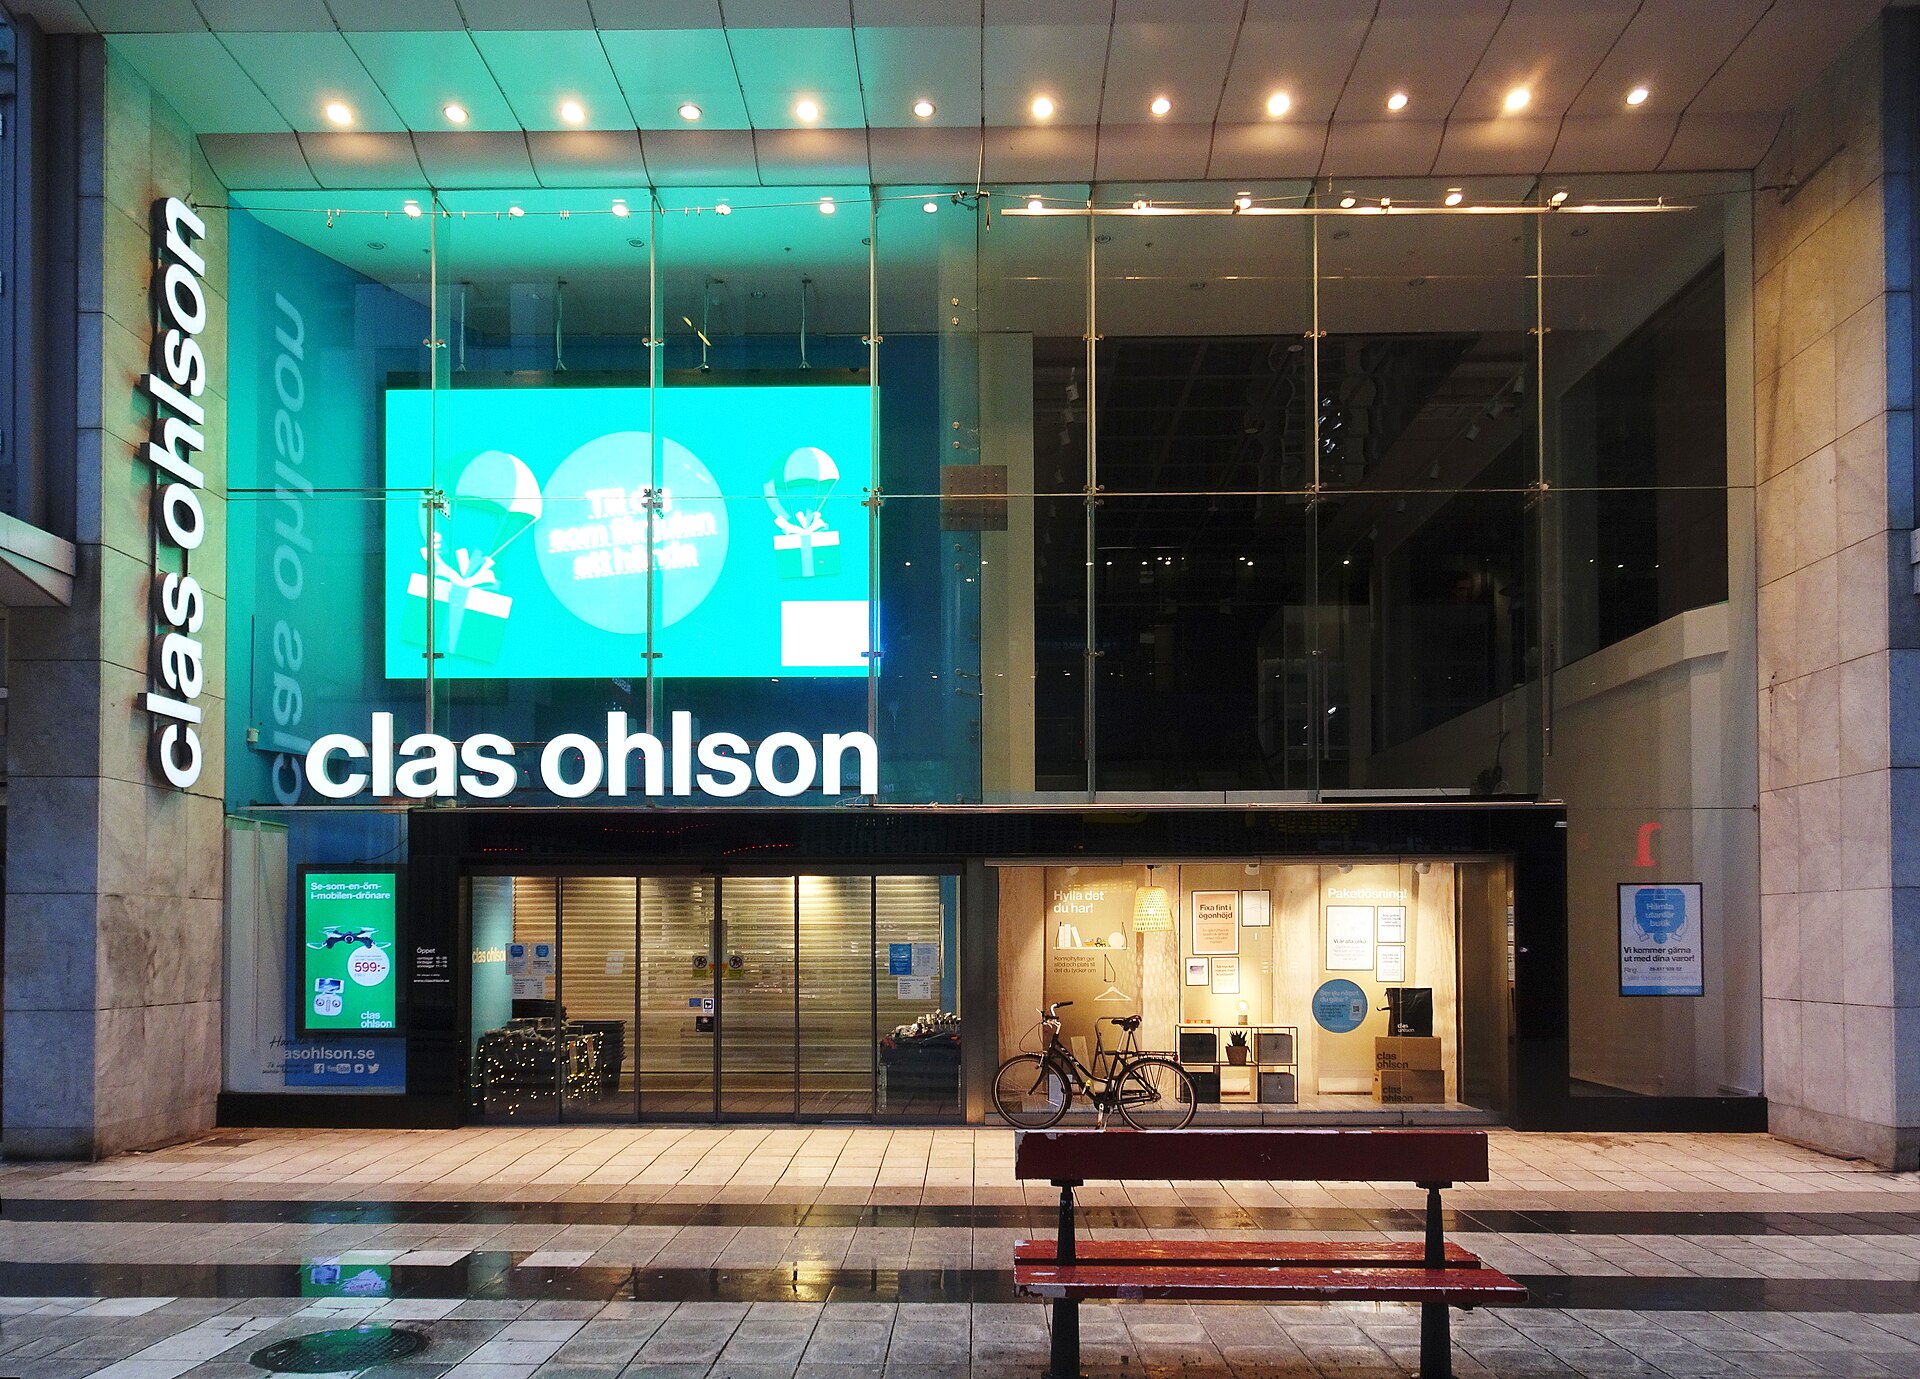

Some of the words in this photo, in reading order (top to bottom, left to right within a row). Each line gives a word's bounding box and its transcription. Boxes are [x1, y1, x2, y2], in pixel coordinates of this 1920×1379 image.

[147, 195, 208, 551] ohlson
[146, 571, 206, 790] clas
[305, 711, 517, 799] clas
[540, 711, 879, 798] ohlson
[310, 891, 391, 900] i-mobilen-drönare
[1053, 890, 1083, 903] Hylla
[1084, 890, 1105, 901] det
[1327, 888, 1408, 901] Paketlösning!
[1053, 902, 1069, 913] du
[1070, 902, 1094, 913] har!
[1198, 911, 1233, 920] ögonhöjd
[471, 946, 486, 964] clas
[1623, 946, 1632, 954] Vi
[1633, 946, 1666, 954] kommer
[1667, 947, 1692, 955] gärna
[354, 961, 386, 973] 599:-
[360, 1010, 381, 1020] clas
[360, 1019, 393, 1029] ohlson
[284, 1046, 376, 1060] asohlson.se
[1376, 1051, 1397, 1060] clas
[1376, 1060, 1409, 1069] ohlson
[1382, 1085, 1402, 1094] clas
[1382, 1095, 1414, 1103] ohlson
